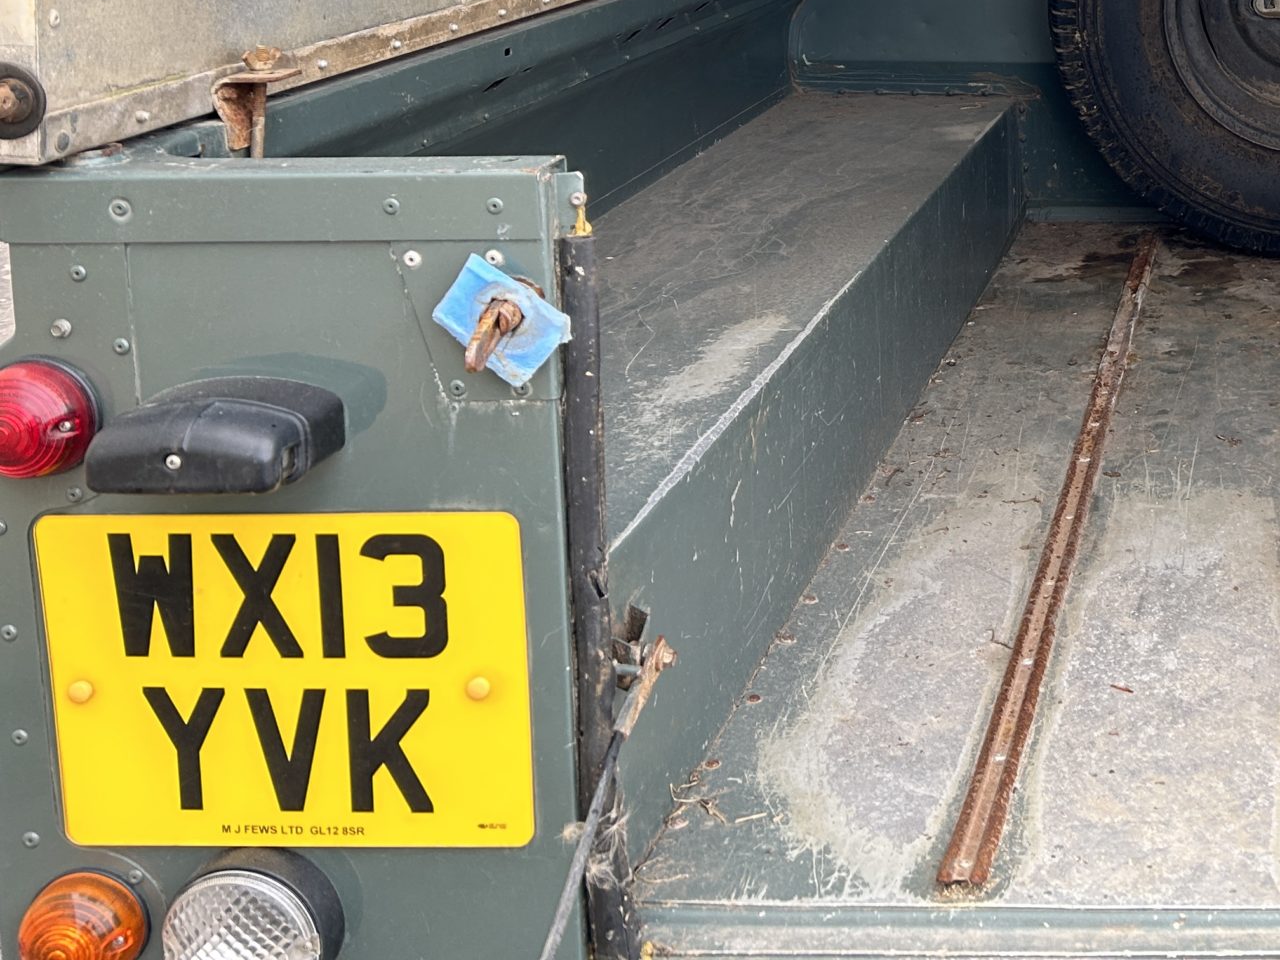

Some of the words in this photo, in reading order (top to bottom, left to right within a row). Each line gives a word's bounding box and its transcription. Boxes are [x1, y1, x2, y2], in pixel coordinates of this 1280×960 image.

[107, 533, 449, 659] WX13
[142, 687, 434, 813] YVK
[221, 824, 232, 833] M
[234, 824, 241, 833] J
[244, 824, 278, 835] FEWS
[281, 825, 304, 835] LTD
[310, 826, 339, 836] GL12
[342, 826, 365, 836] 8SR
